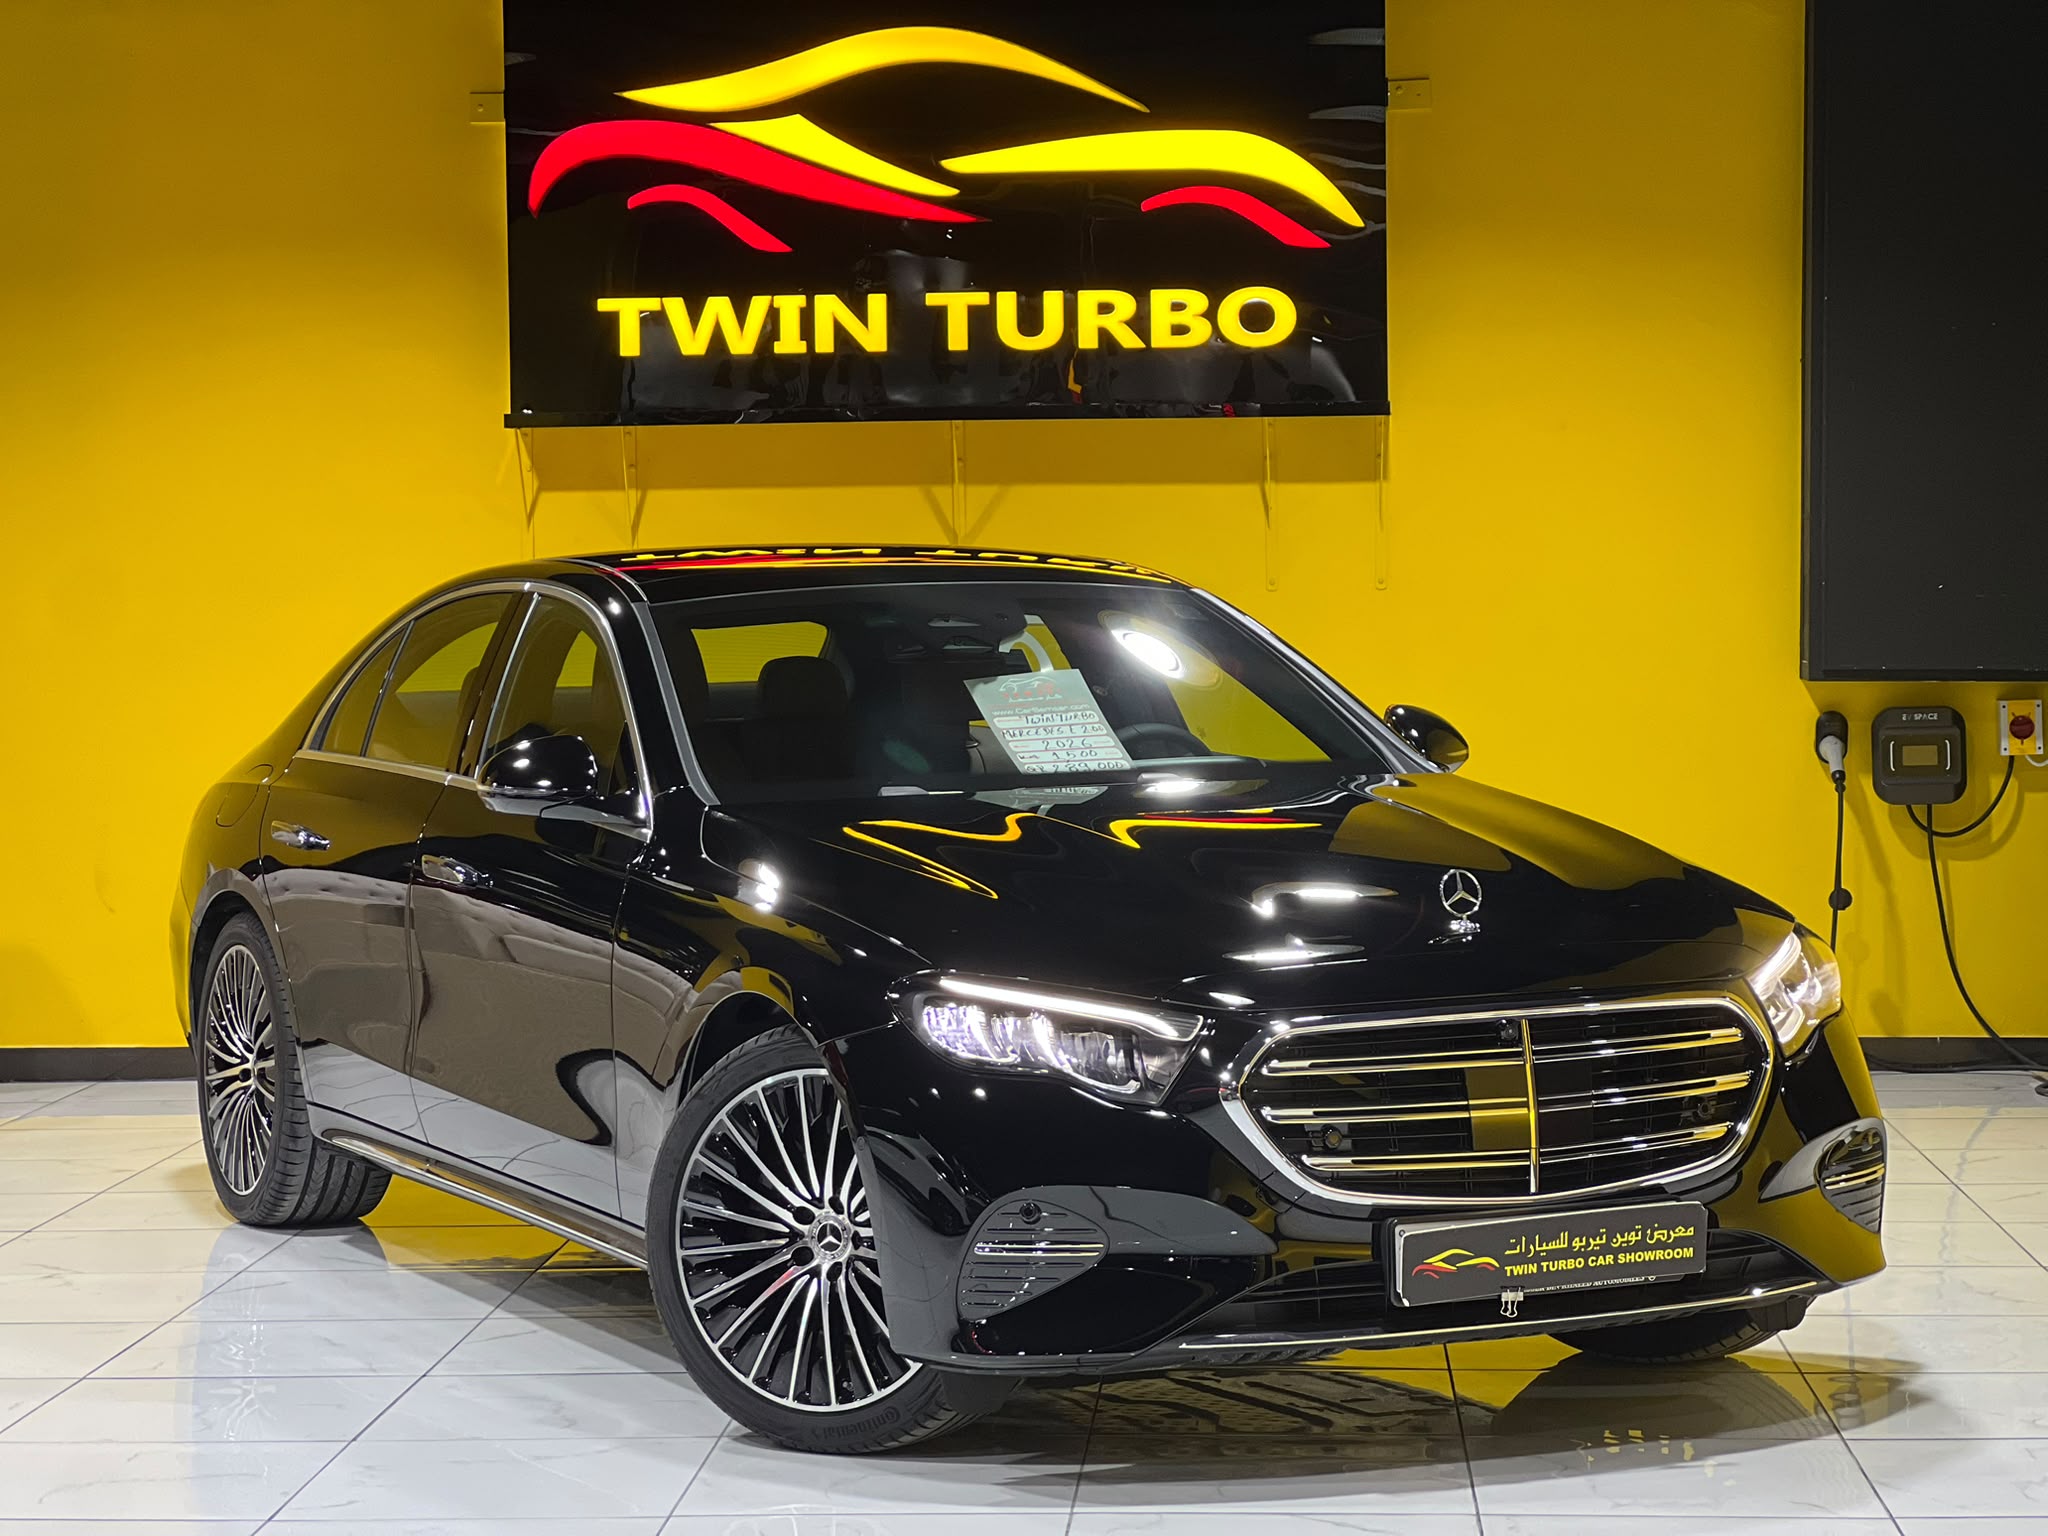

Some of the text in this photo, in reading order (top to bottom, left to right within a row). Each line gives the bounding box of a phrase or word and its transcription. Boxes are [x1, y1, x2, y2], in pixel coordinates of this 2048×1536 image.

[597, 286, 1298, 357] TWIN TURBO
[1914, 712, 1938, 721] SPACE
[1041, 738, 1092, 750] 2026
[1504, 1223, 1695, 1258] معرض توين تيربو للسيارات
[1504, 1247, 1694, 1277] TWIN TURBO CAR SHOWROOM
